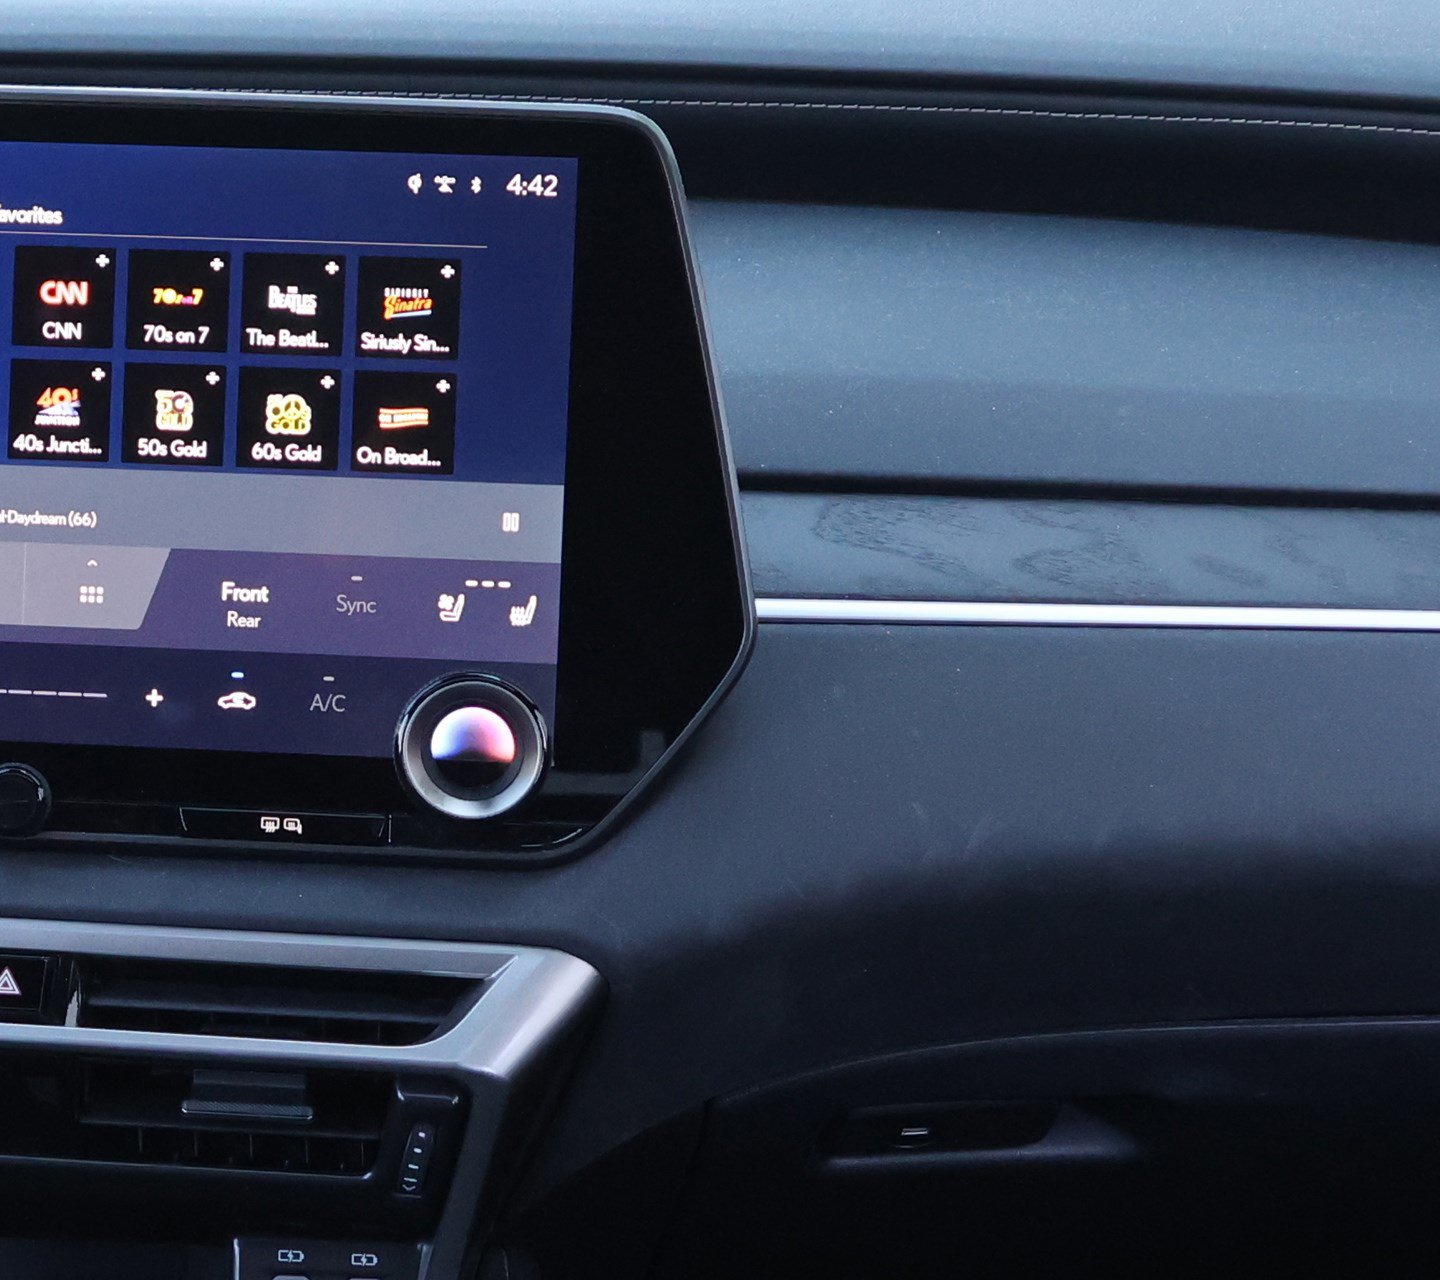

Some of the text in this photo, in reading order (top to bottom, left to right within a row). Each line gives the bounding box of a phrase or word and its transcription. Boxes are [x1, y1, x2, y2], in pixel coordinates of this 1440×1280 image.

[506, 174, 559, 197] 4:42
[39, 280, 89, 306] CNN
[191, 288, 203, 305] 7
[383, 295, 433, 320] Sinatra
[42, 321, 83, 340] CNN
[143, 324, 210, 344] 70s on 7
[246, 327, 276, 346] The
[361, 332, 412, 354] Siriusly
[13, 434, 44, 453] 40s
[137, 438, 208, 458] 50s Gold
[251, 442, 322, 462] 60s Gold
[356, 446, 381, 464] On
[68, 510, 97, 528] (66)
[221, 581, 270, 604] Front
[336, 594, 377, 615] Sync
[227, 611, 261, 629] Rear
[309, 693, 347, 715] A/C
